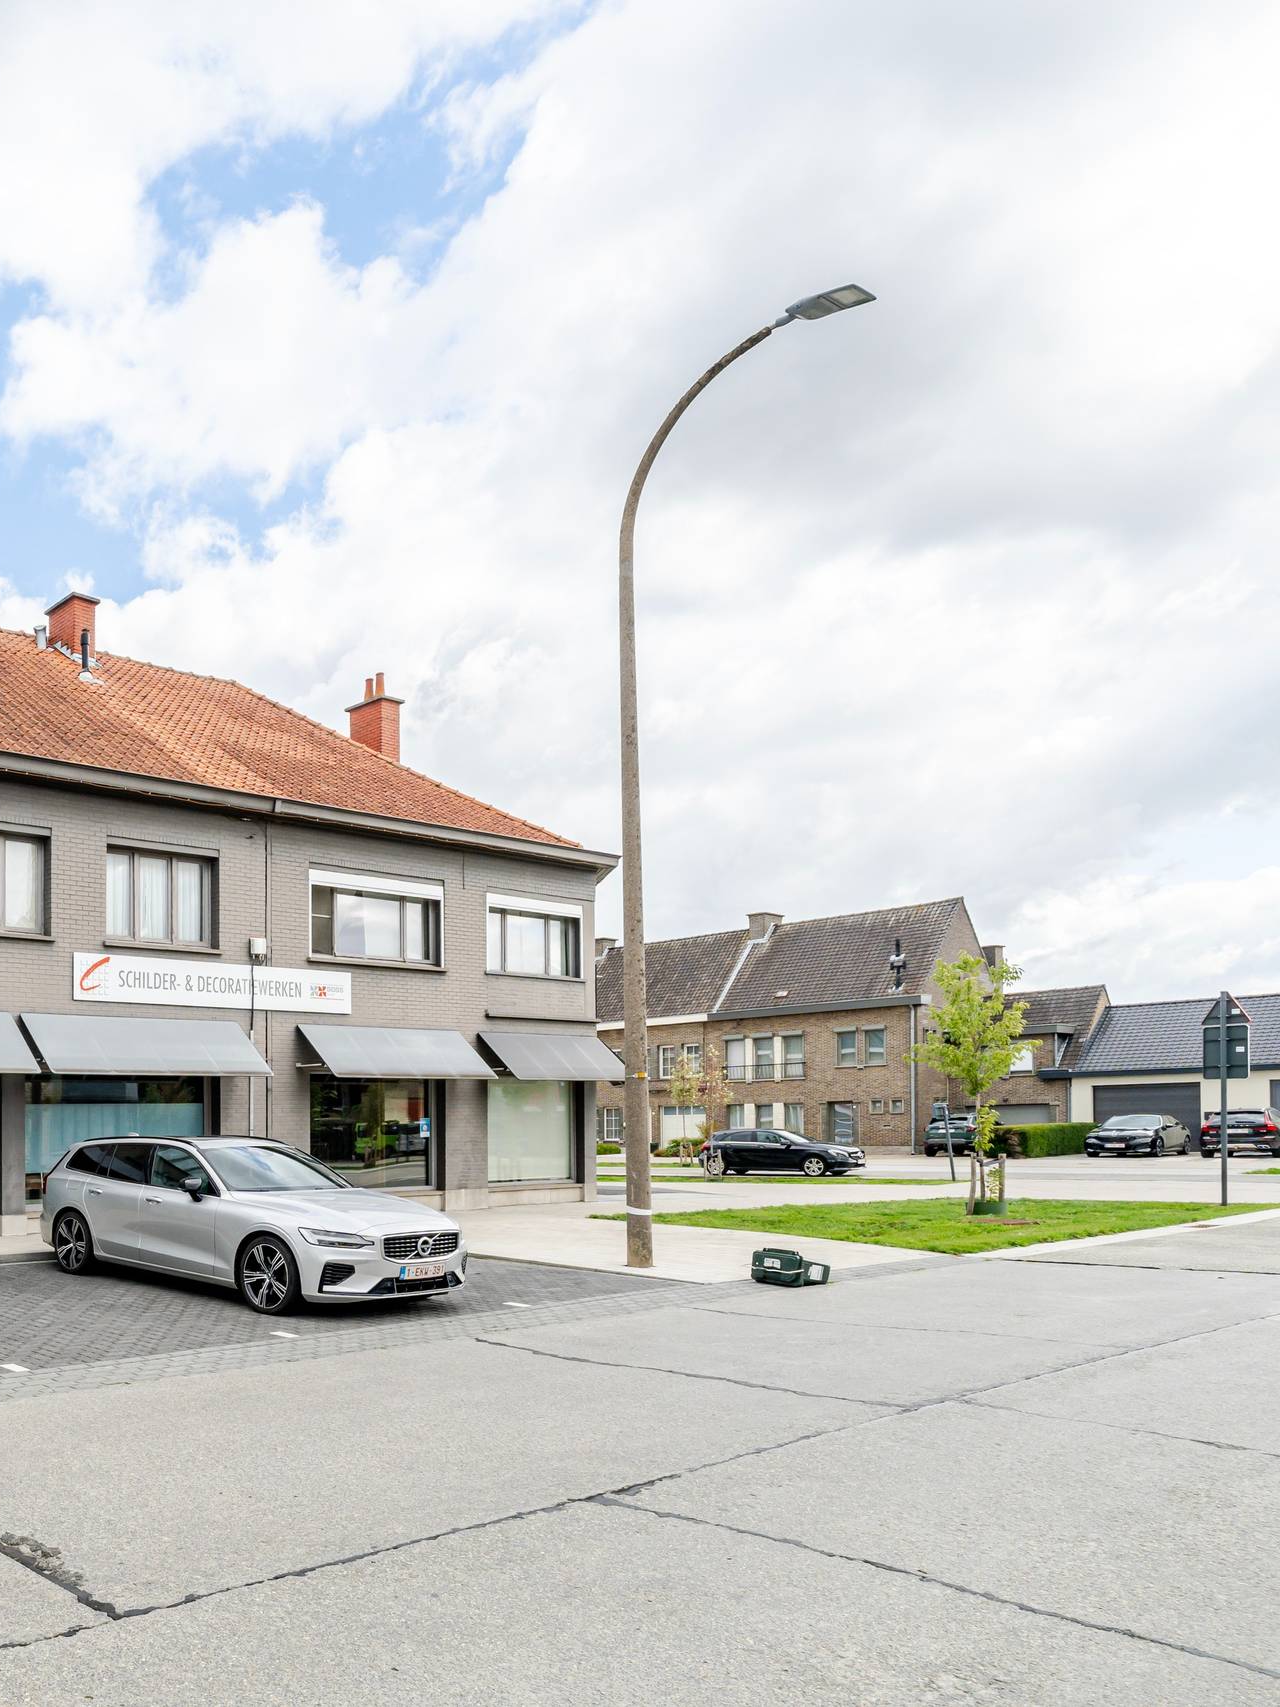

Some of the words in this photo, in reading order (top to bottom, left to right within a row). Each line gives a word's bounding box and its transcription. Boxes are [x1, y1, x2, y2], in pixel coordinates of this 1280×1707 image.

[118, 970, 181, 991] SCHILDER-
[185, 974, 193, 992] &
[197, 975, 302, 998] DECORATIEWERKEN
